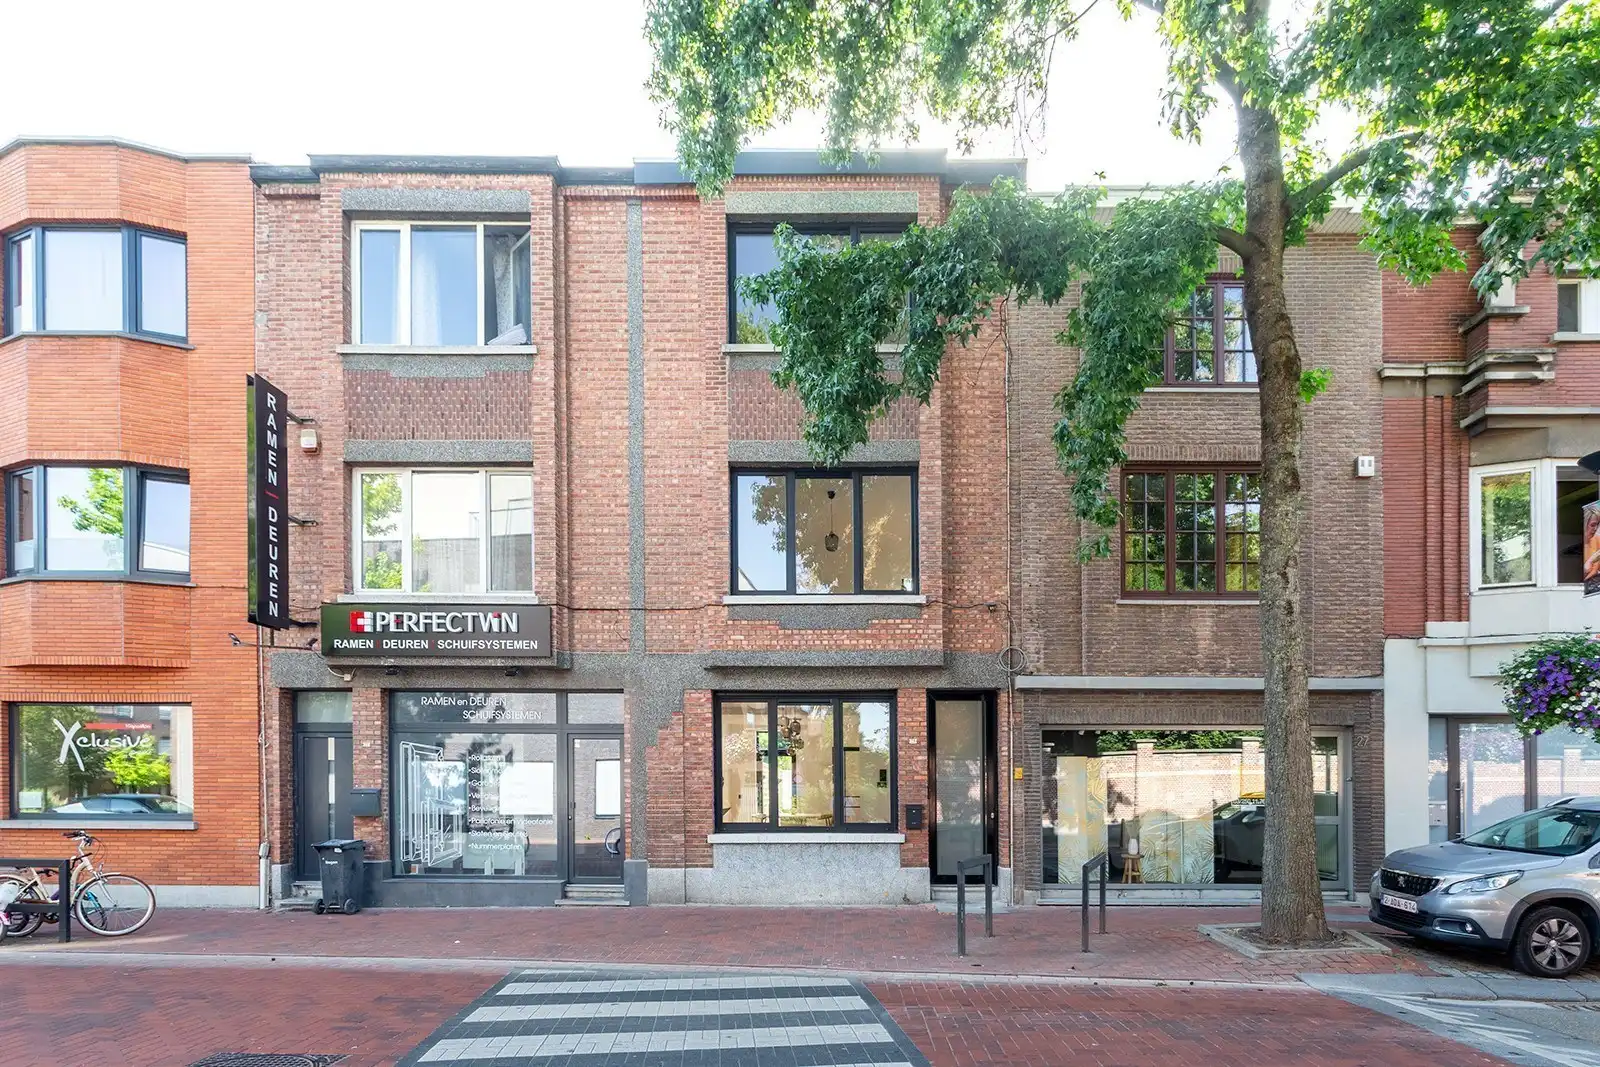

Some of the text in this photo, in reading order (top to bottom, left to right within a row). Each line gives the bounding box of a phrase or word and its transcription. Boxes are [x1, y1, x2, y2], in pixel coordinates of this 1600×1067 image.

[266, 392, 279, 618] RAMEN DEUREN
[334, 639, 538, 651] RAMEN DEUREN SCHUIFSYSTEMEN
[421, 696, 456, 706] RAMEN
[469, 697, 507, 706] DEUREN
[462, 710, 542, 720] SCHUIFSYSTEMEN
